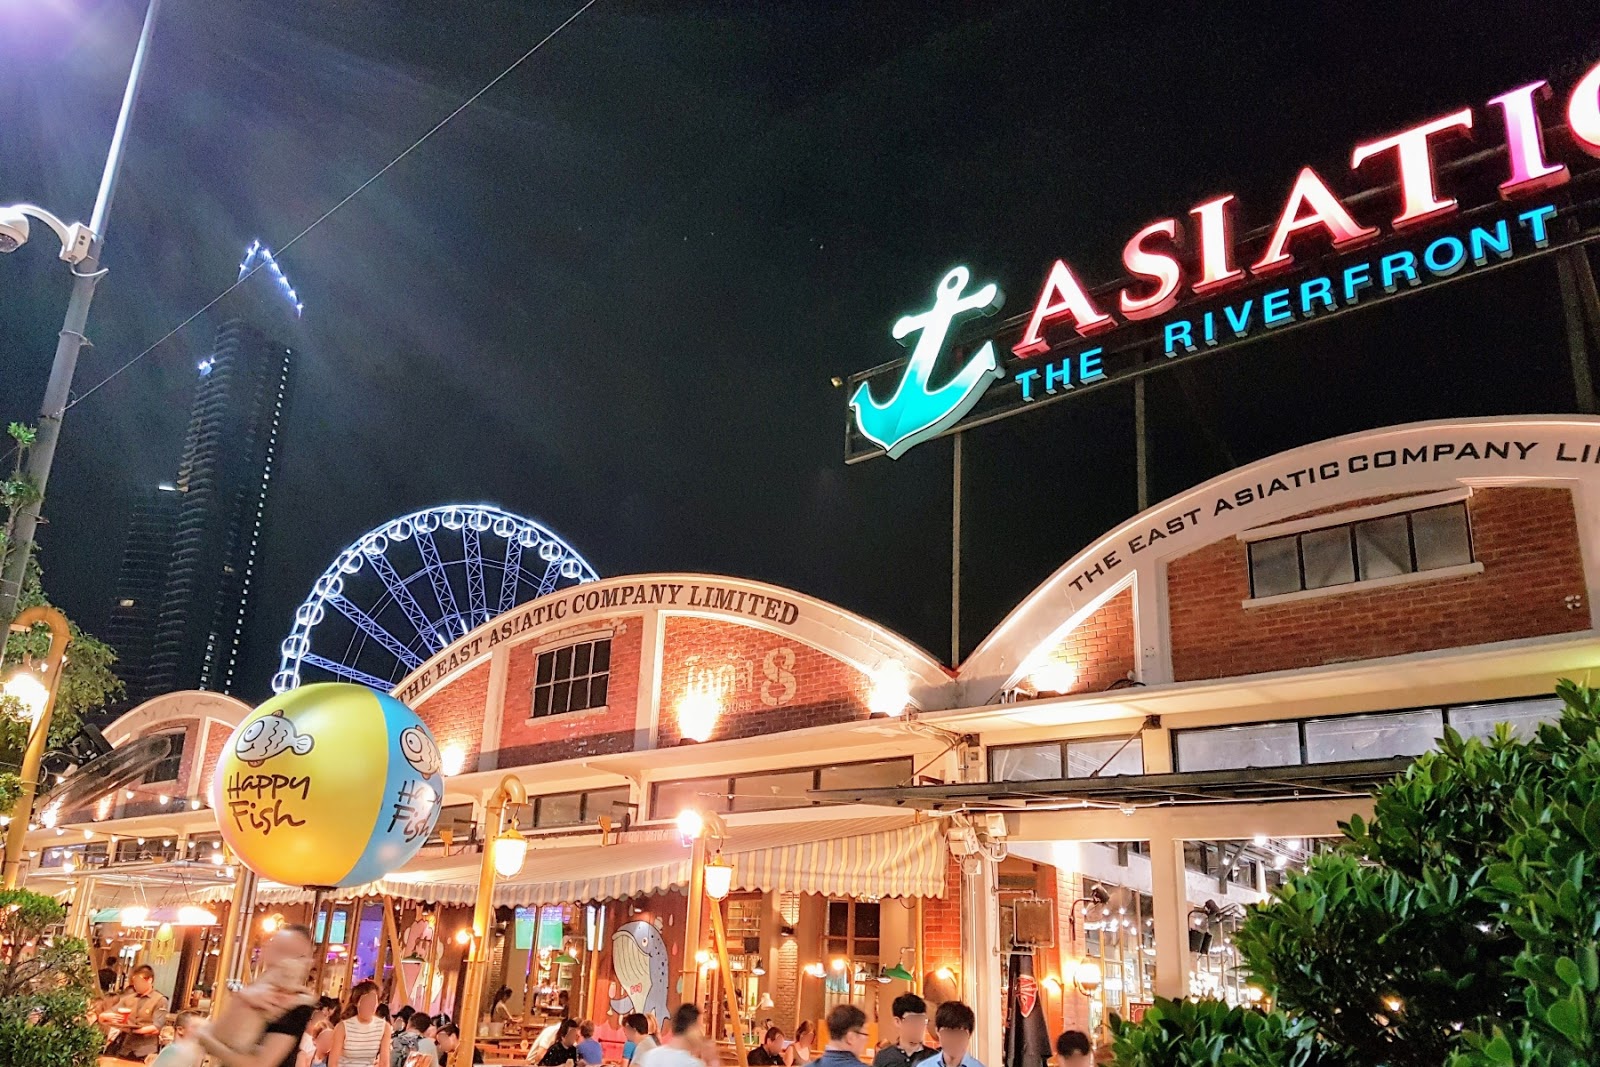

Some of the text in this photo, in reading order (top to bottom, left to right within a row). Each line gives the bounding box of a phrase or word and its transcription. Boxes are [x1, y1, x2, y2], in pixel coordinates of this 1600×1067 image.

[1014, 204, 1556, 401] THE RIVERFRONT
[1068, 441, 1600, 592] THE EAST ASIATIC COMPANY LI
[396, 583, 800, 704] THE EAST ASIATIC COMPANY LIMITED
[227, 771, 311, 800] Happy
[228, 799, 307, 836] Fish
[387, 803, 431, 844] Fish
